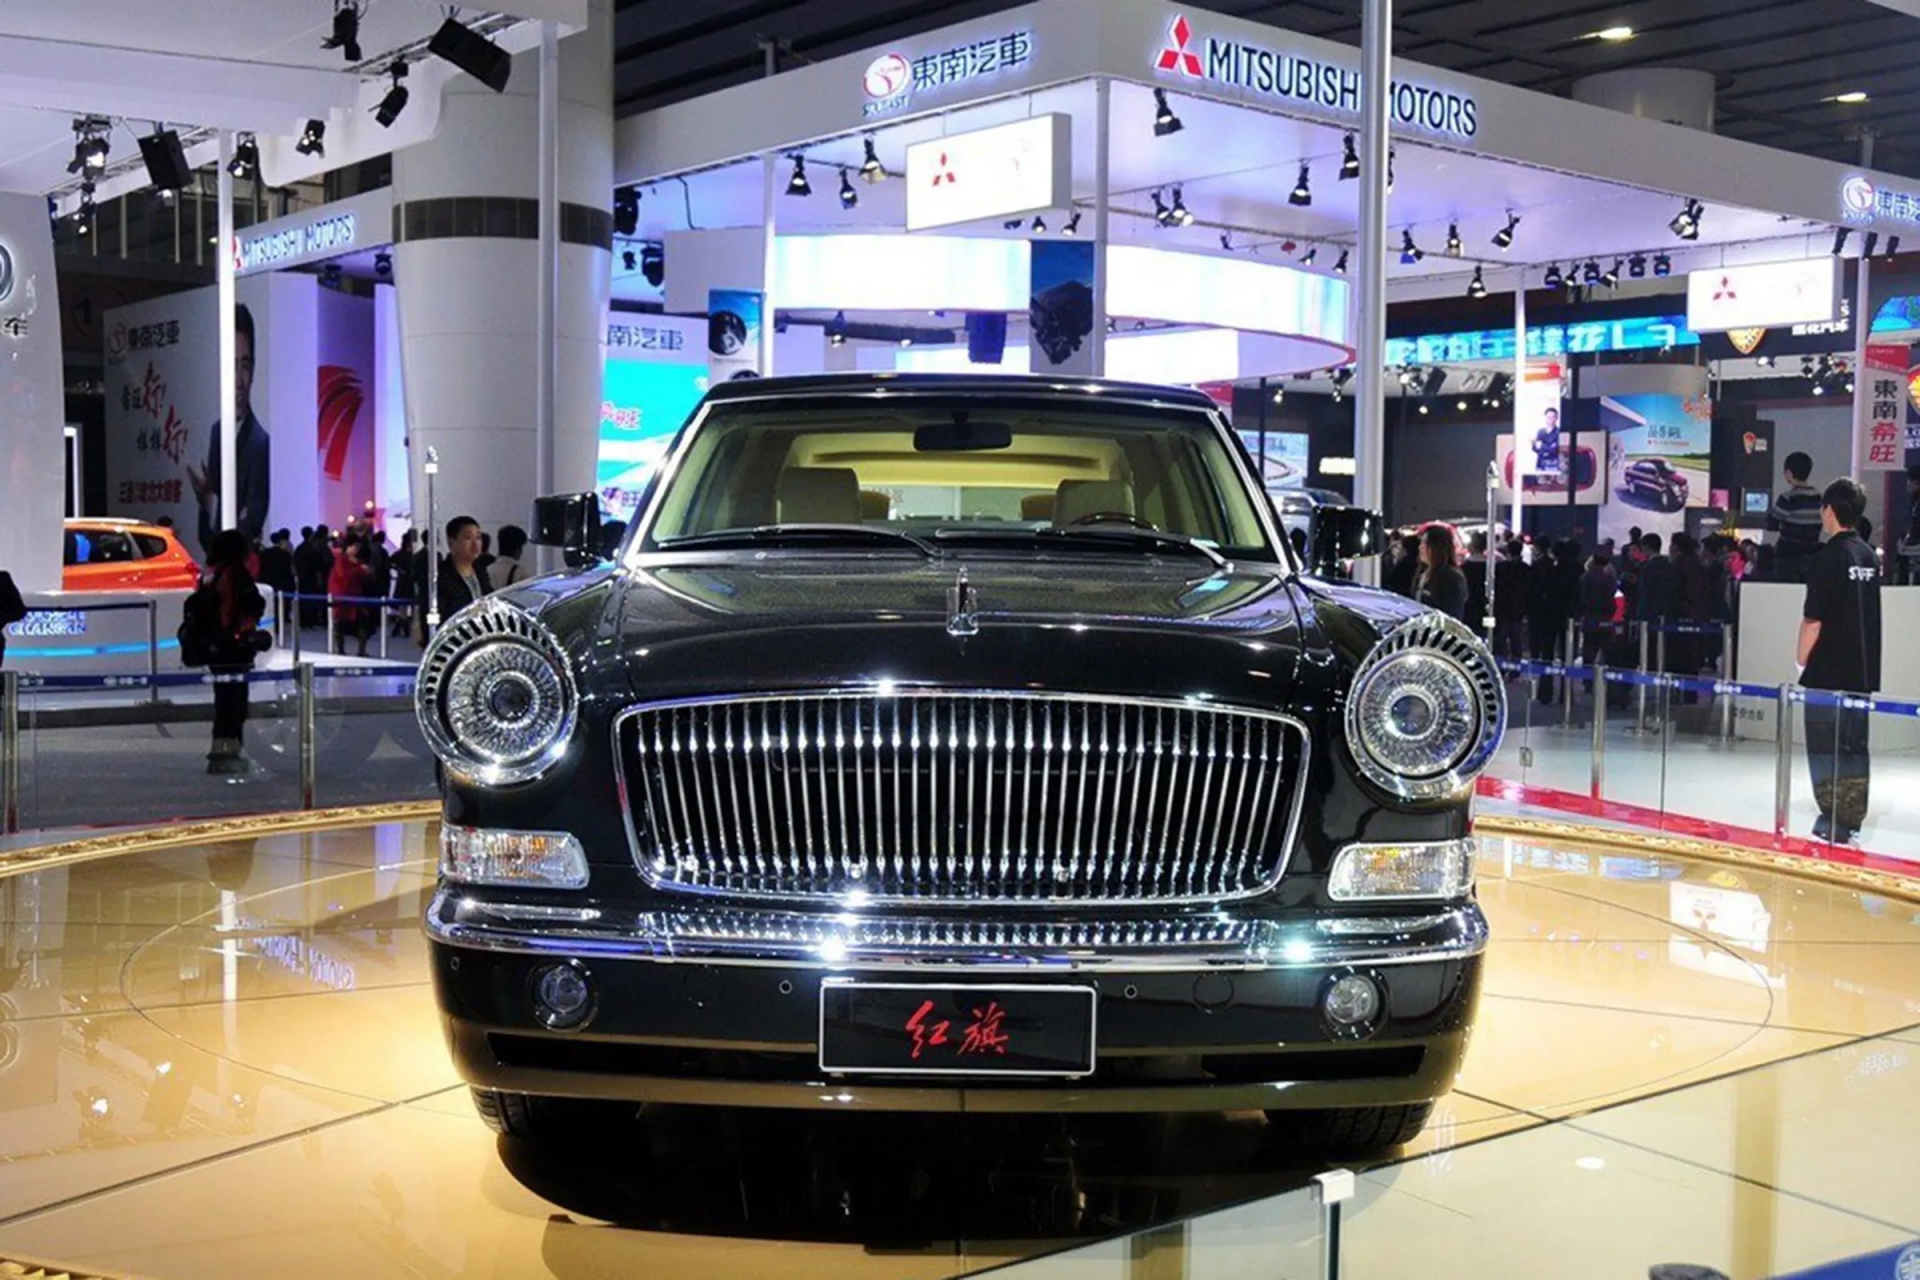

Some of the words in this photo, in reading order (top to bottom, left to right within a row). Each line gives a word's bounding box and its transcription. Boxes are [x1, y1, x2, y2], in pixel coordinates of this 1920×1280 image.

[912, 31, 1029, 90] 東南汽車
[1206, 38, 1361, 112] MITSUBISH
[1868, 379, 1899, 463] 東南希旺
[905, 1000, 1009, 1060] 红旗
